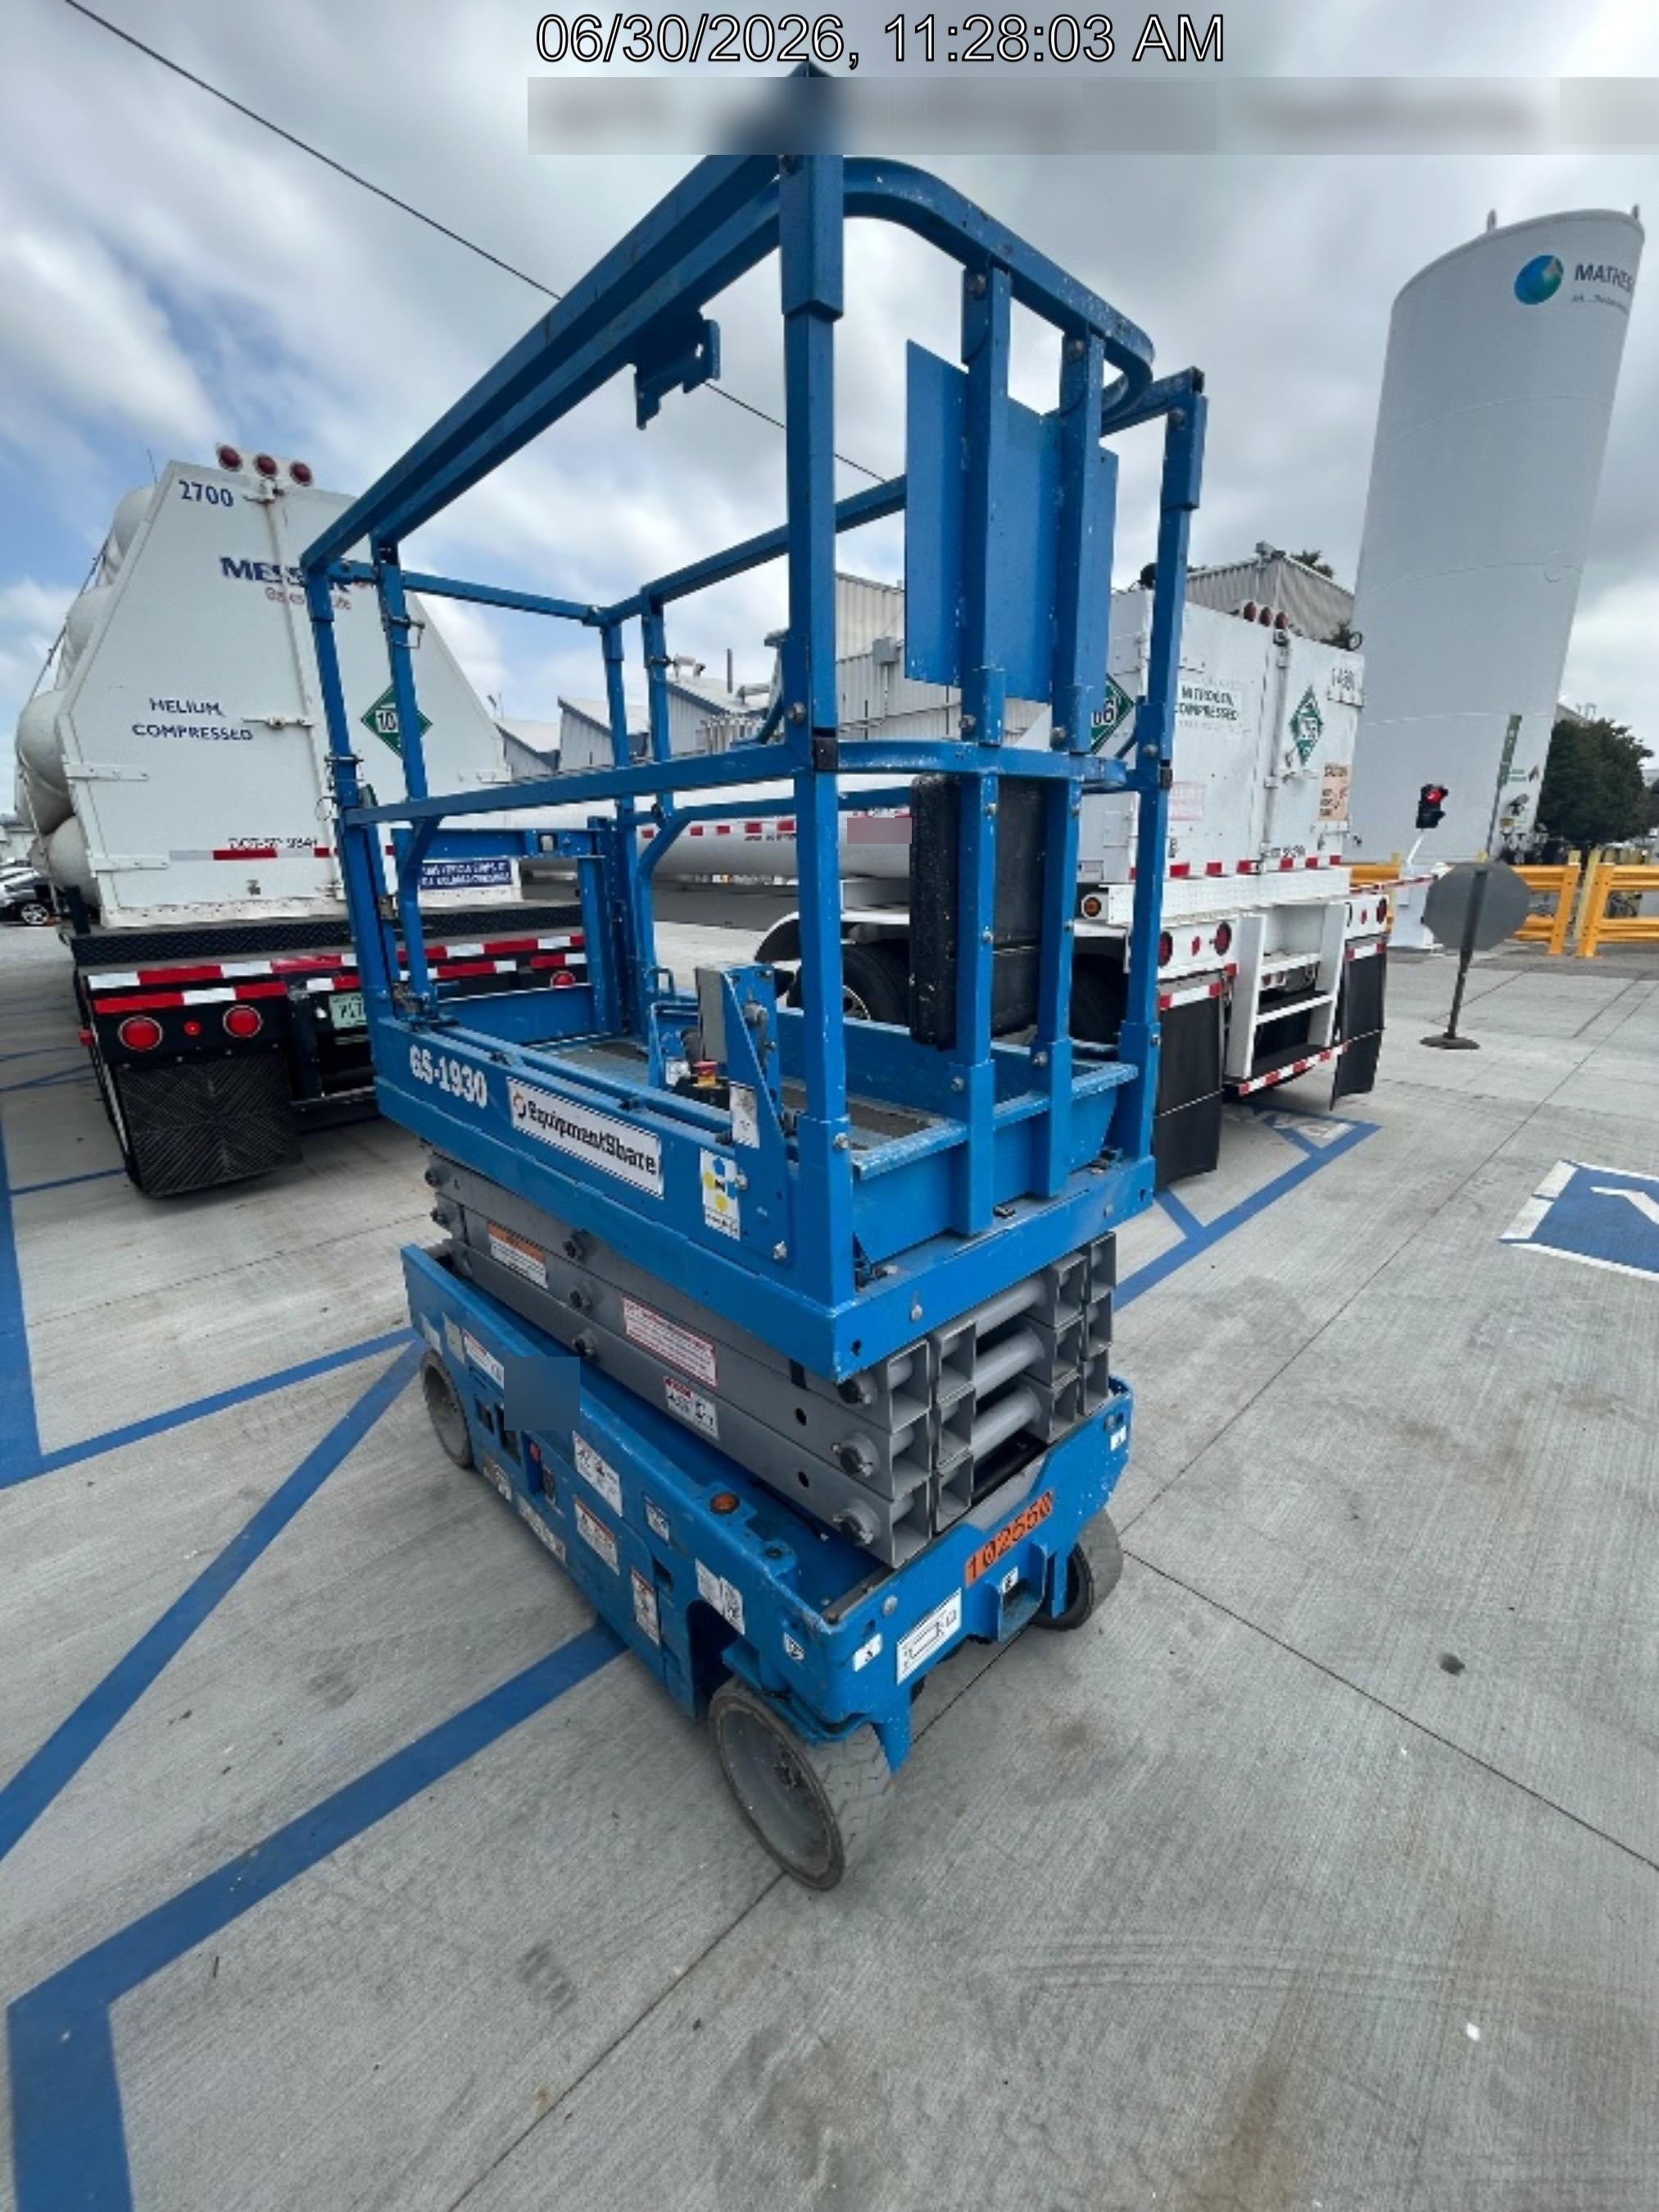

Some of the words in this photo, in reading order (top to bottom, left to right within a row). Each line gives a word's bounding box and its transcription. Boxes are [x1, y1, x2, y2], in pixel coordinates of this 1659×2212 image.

[178, 478, 233, 507] 2700
[131, 723, 253, 741] COMPRESSED
[410, 1044, 487, 1109] GS-1930
[527, 1099, 658, 1175] EquipmentShare
